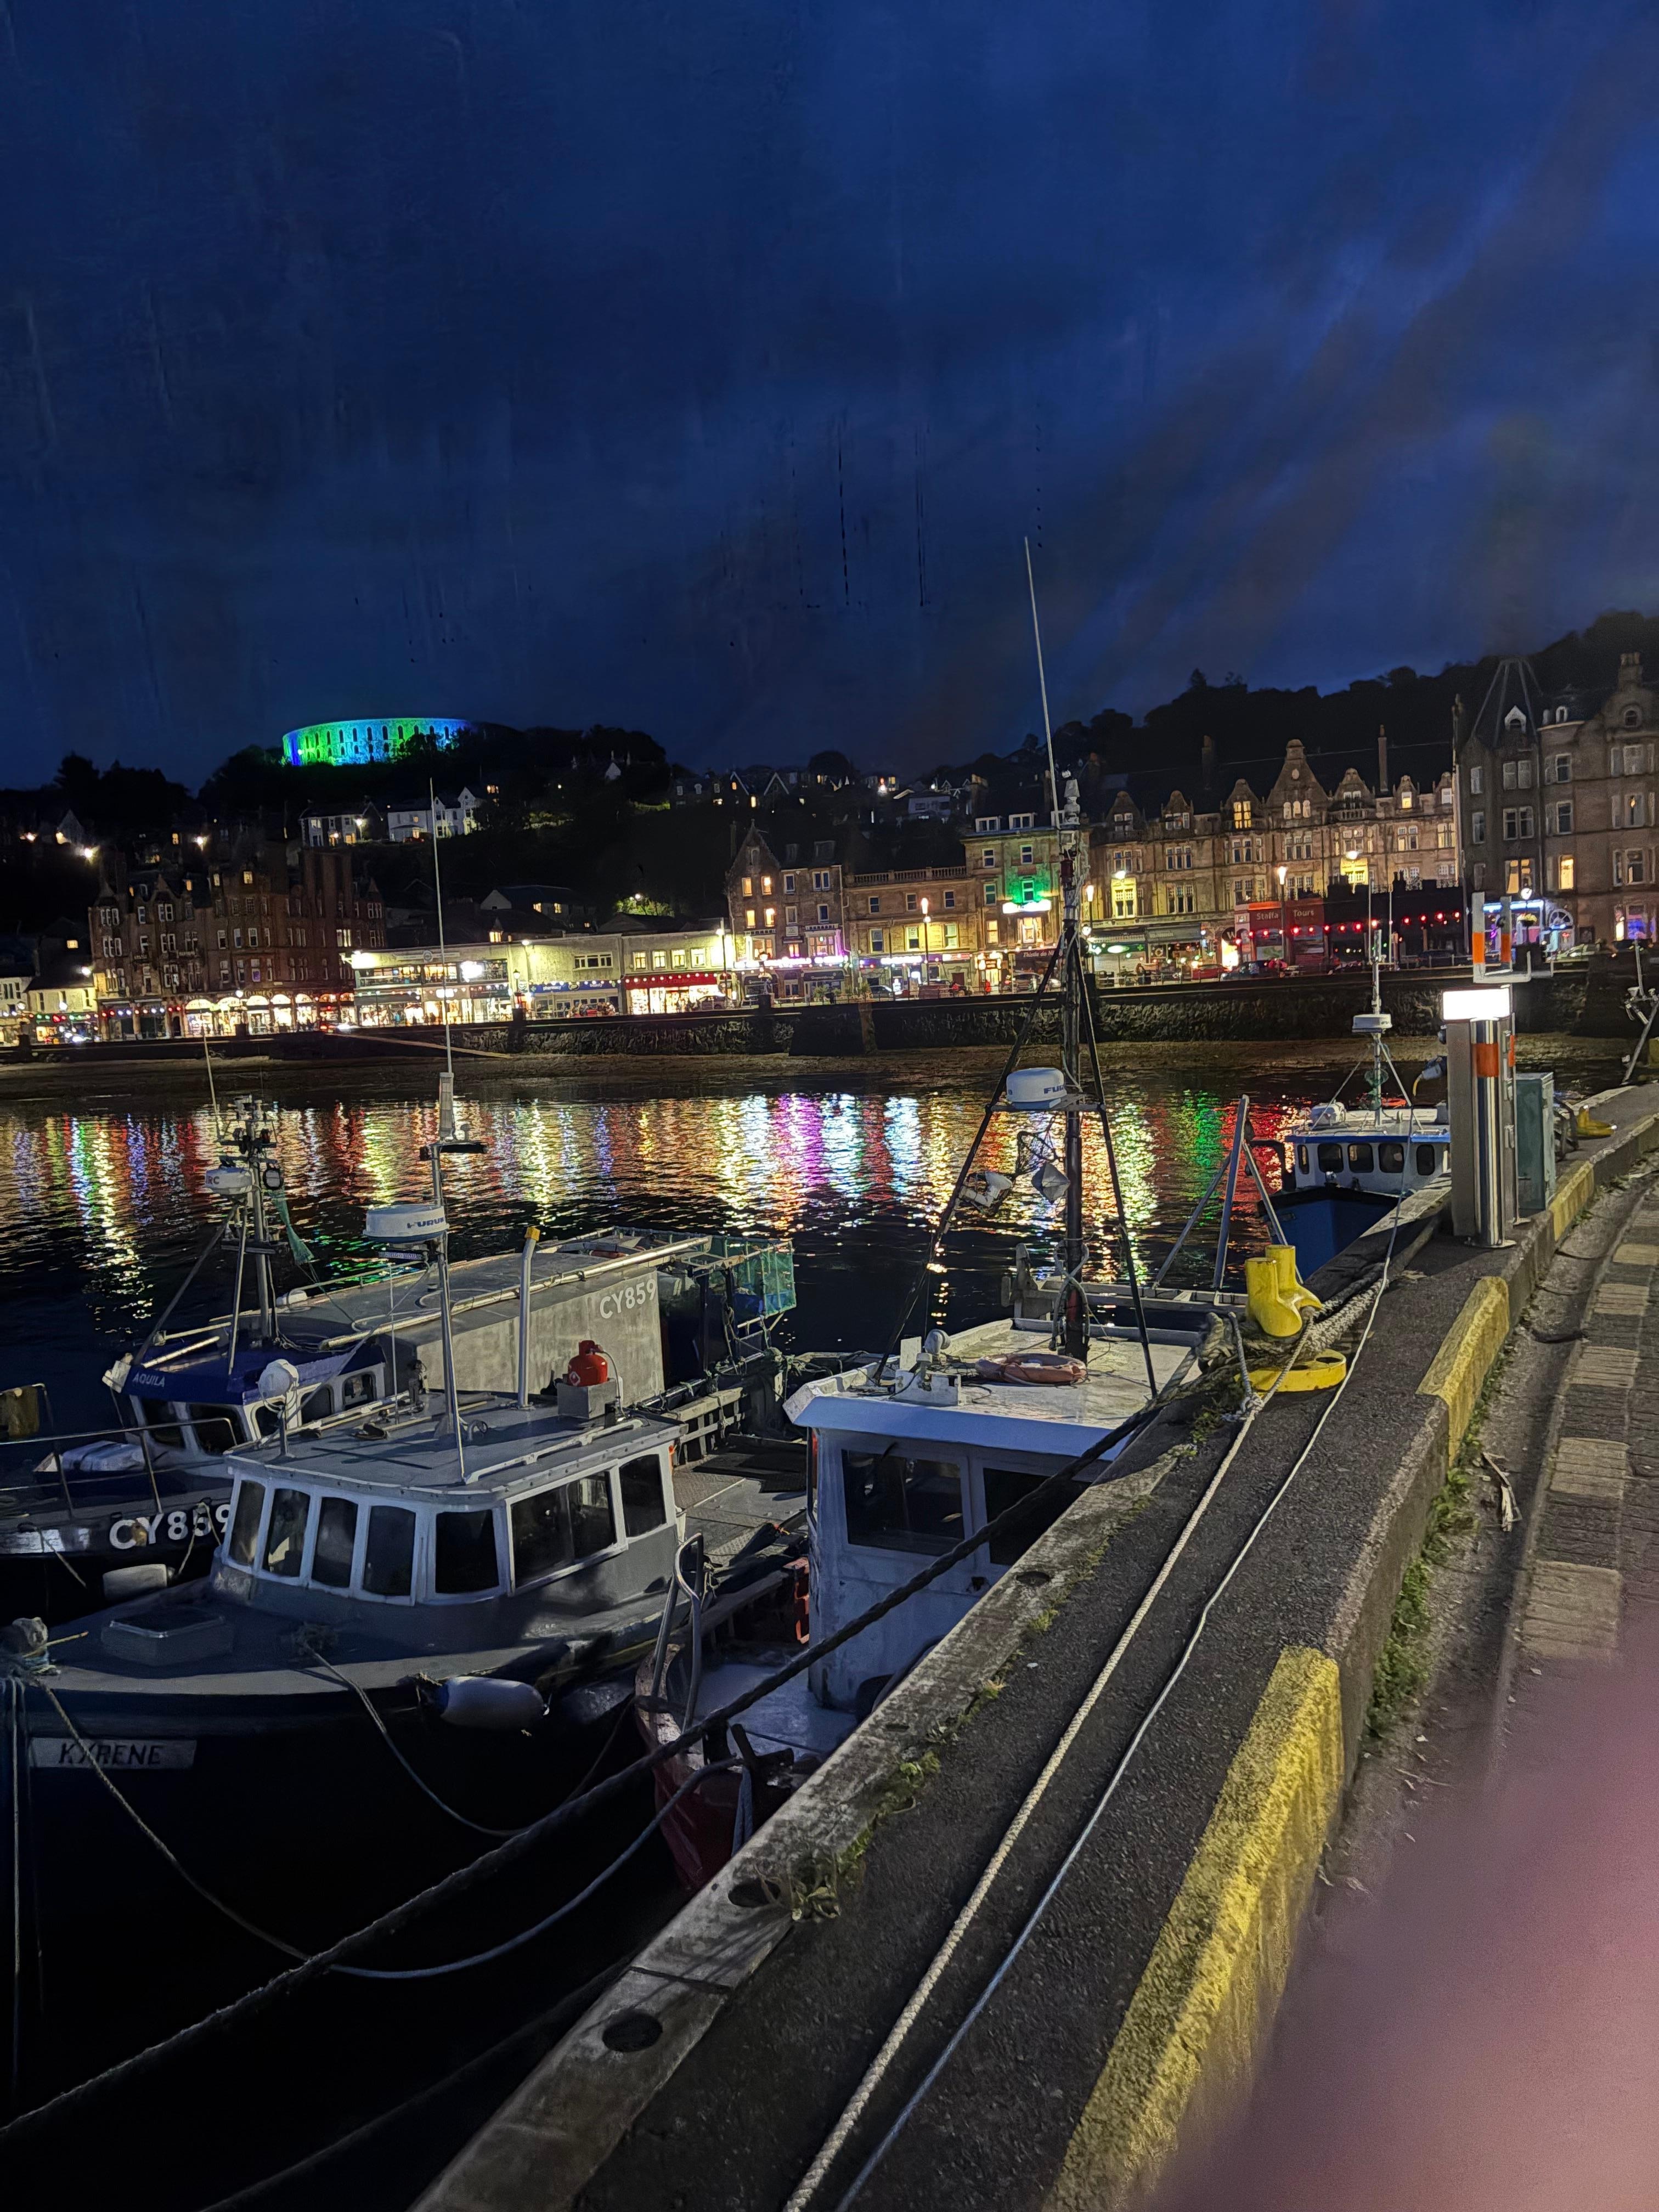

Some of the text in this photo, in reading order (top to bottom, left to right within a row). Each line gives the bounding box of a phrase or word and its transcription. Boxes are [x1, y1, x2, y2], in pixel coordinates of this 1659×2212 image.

[1256, 909, 1314, 920] Staffa Tours
[600, 1279, 656, 1319] CY859
[132, 1373, 165, 1387] AQUILA
[110, 1504, 232, 1549] CY859
